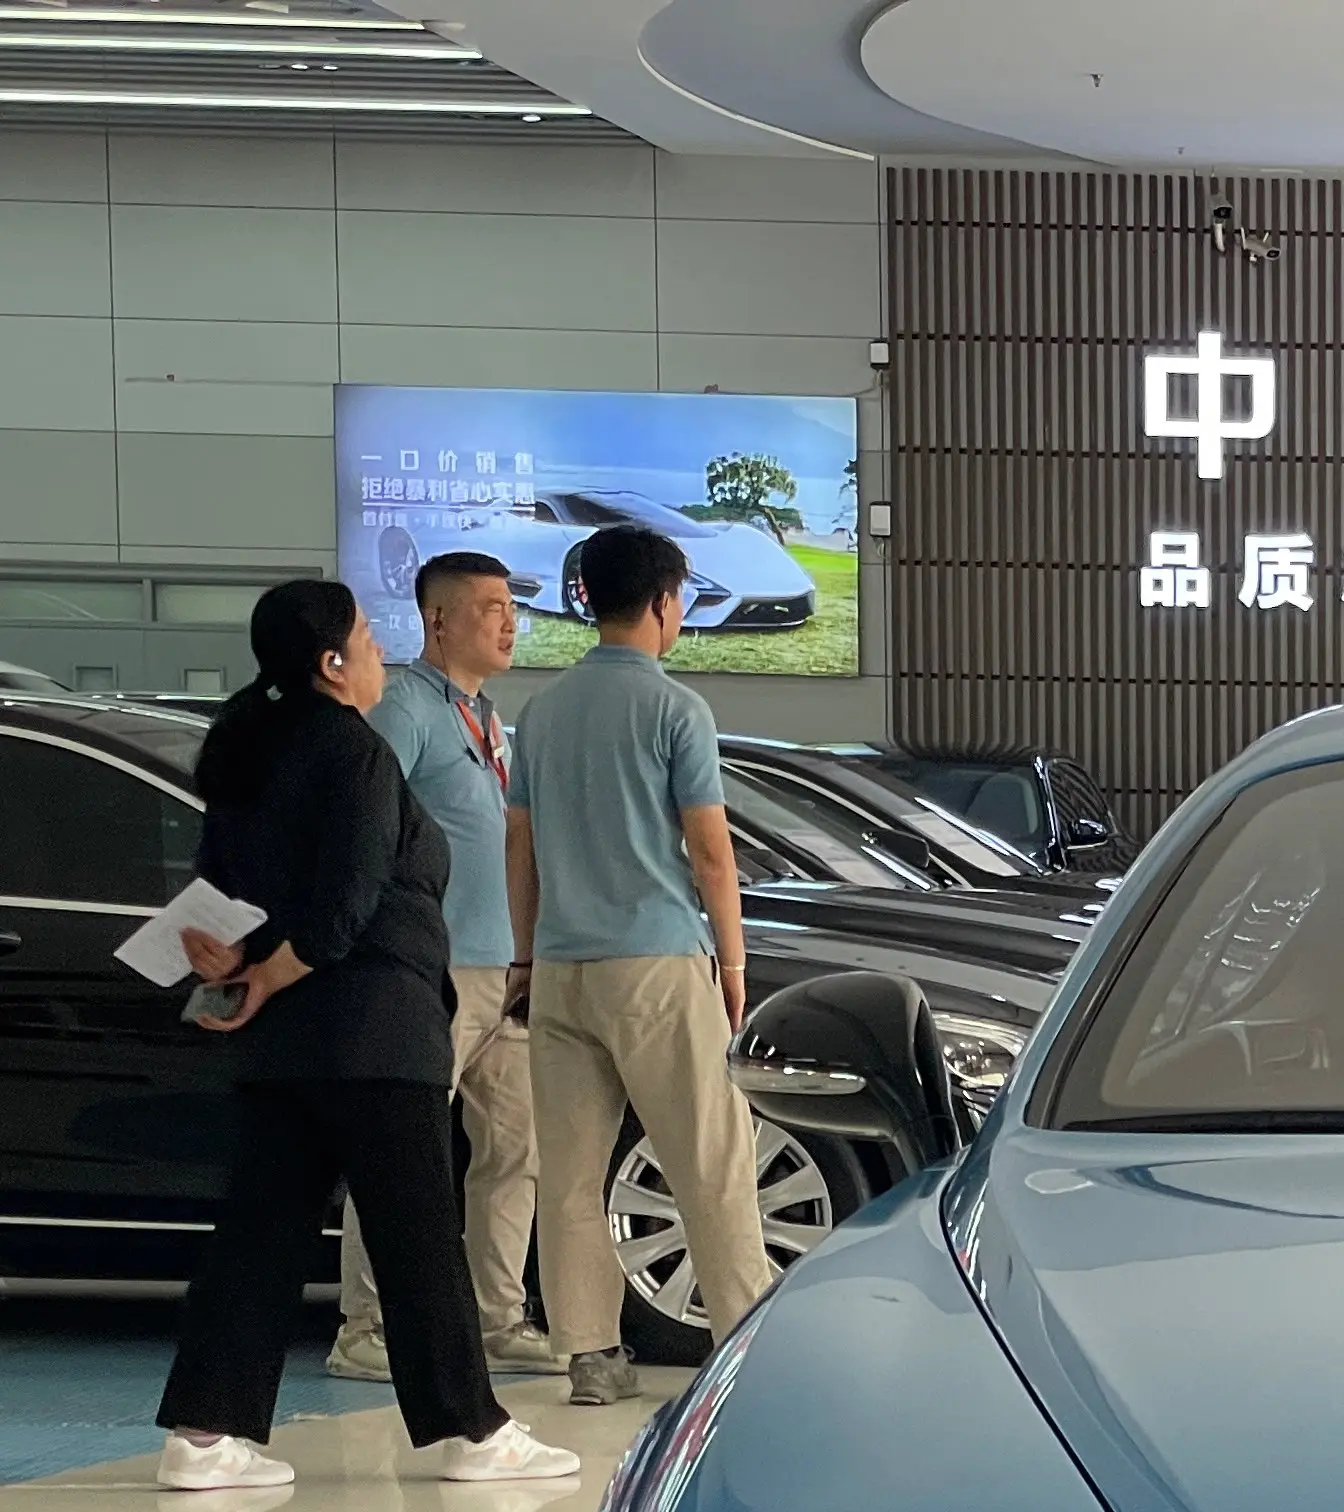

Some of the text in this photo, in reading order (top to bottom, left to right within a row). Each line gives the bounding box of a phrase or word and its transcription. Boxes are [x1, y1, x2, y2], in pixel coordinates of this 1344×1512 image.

[361, 450, 534, 475] 一口价销售
[362, 477, 535, 504] 拒绝暴利省心实惠
